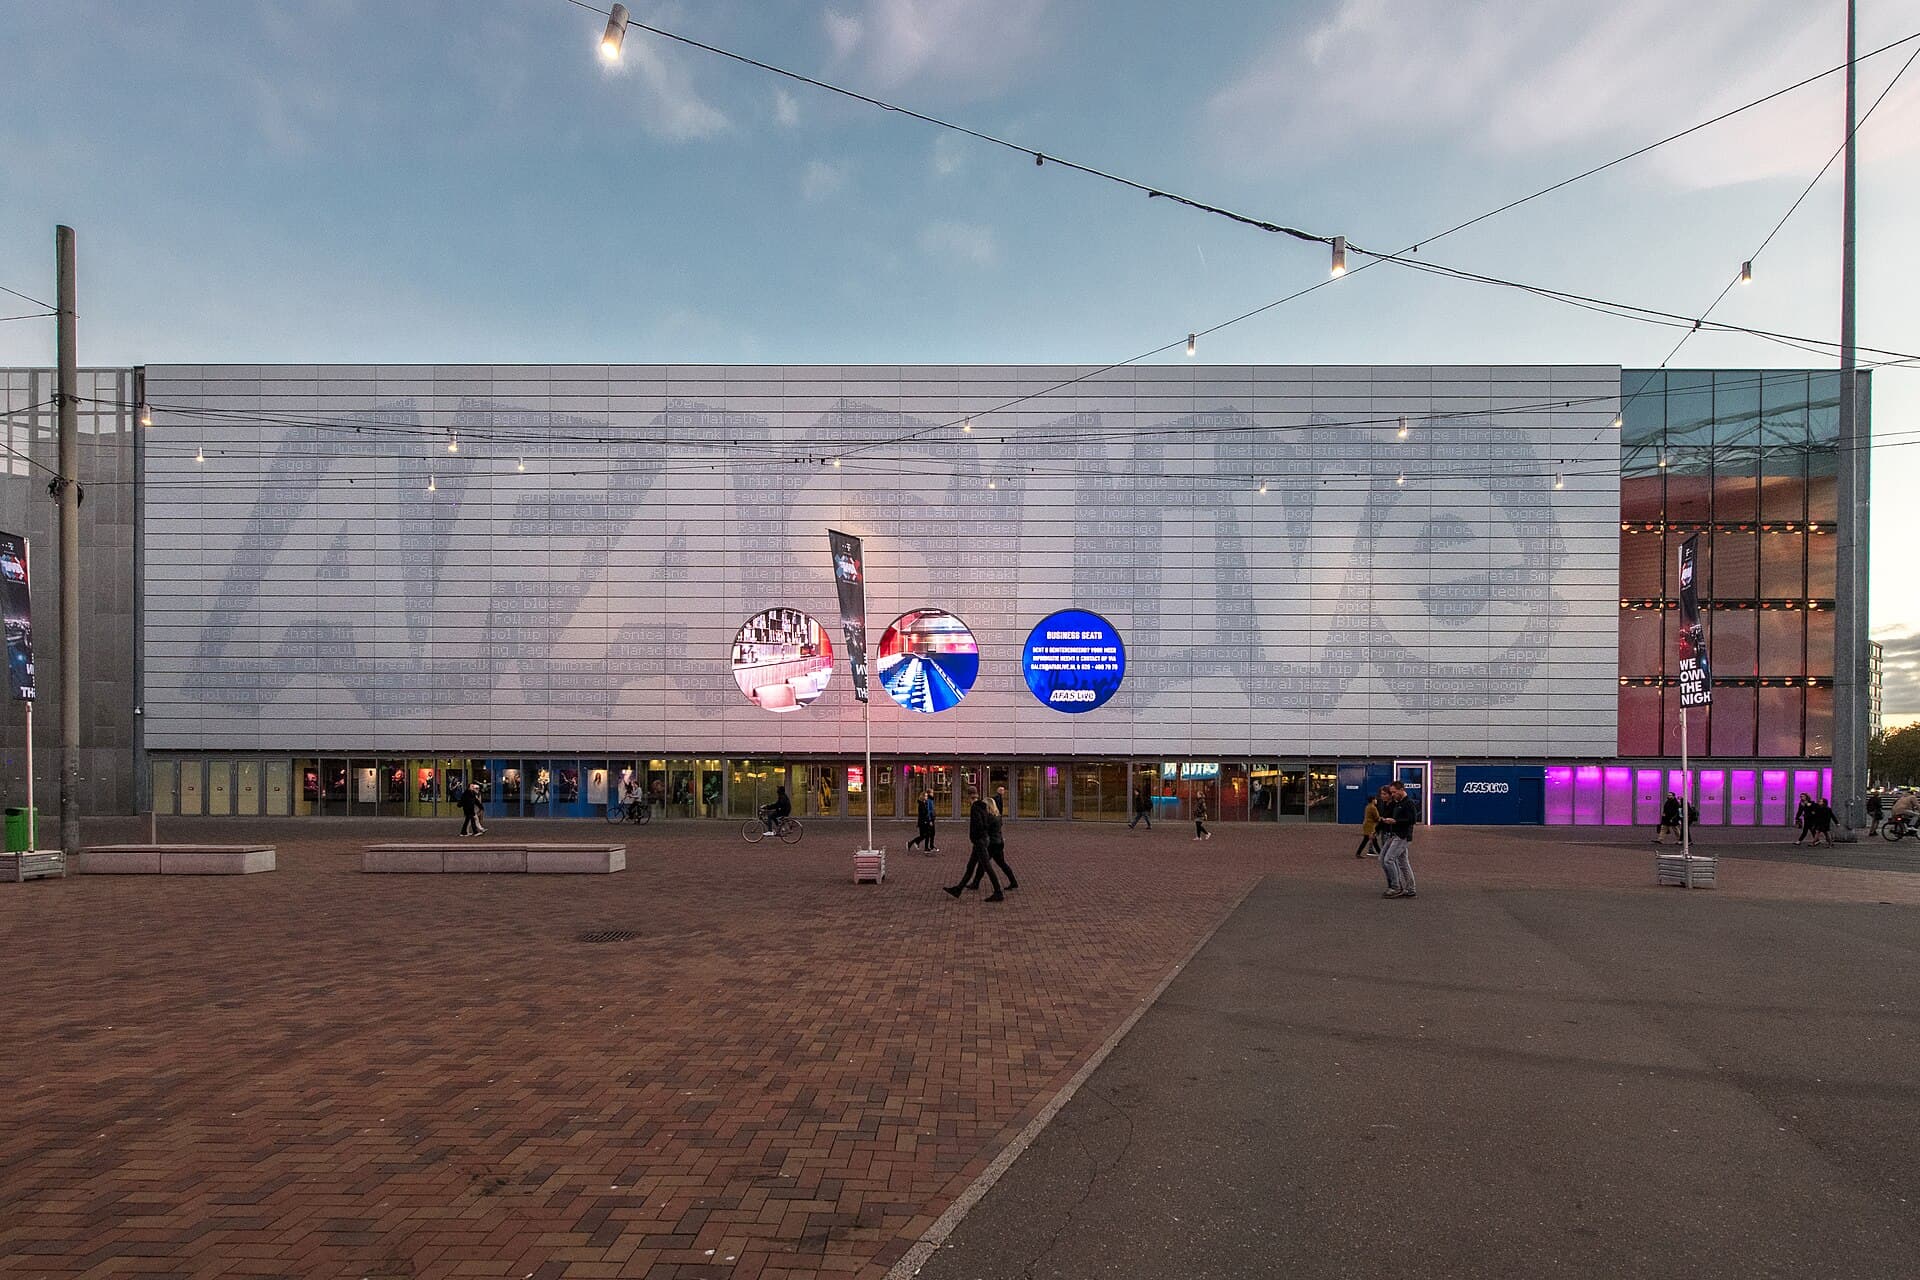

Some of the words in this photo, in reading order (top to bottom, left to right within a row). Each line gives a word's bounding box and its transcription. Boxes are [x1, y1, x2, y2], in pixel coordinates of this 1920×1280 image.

[1047, 631, 1080, 640] BUSINESS
[1081, 631, 1102, 640] SEATS
[1680, 658, 1697, 671] WE
[1681, 681, 1702, 694] THE
[1051, 690, 1075, 701] AFAS
[1463, 782, 1489, 793] AFAS
[1489, 783, 1508, 793] Live
